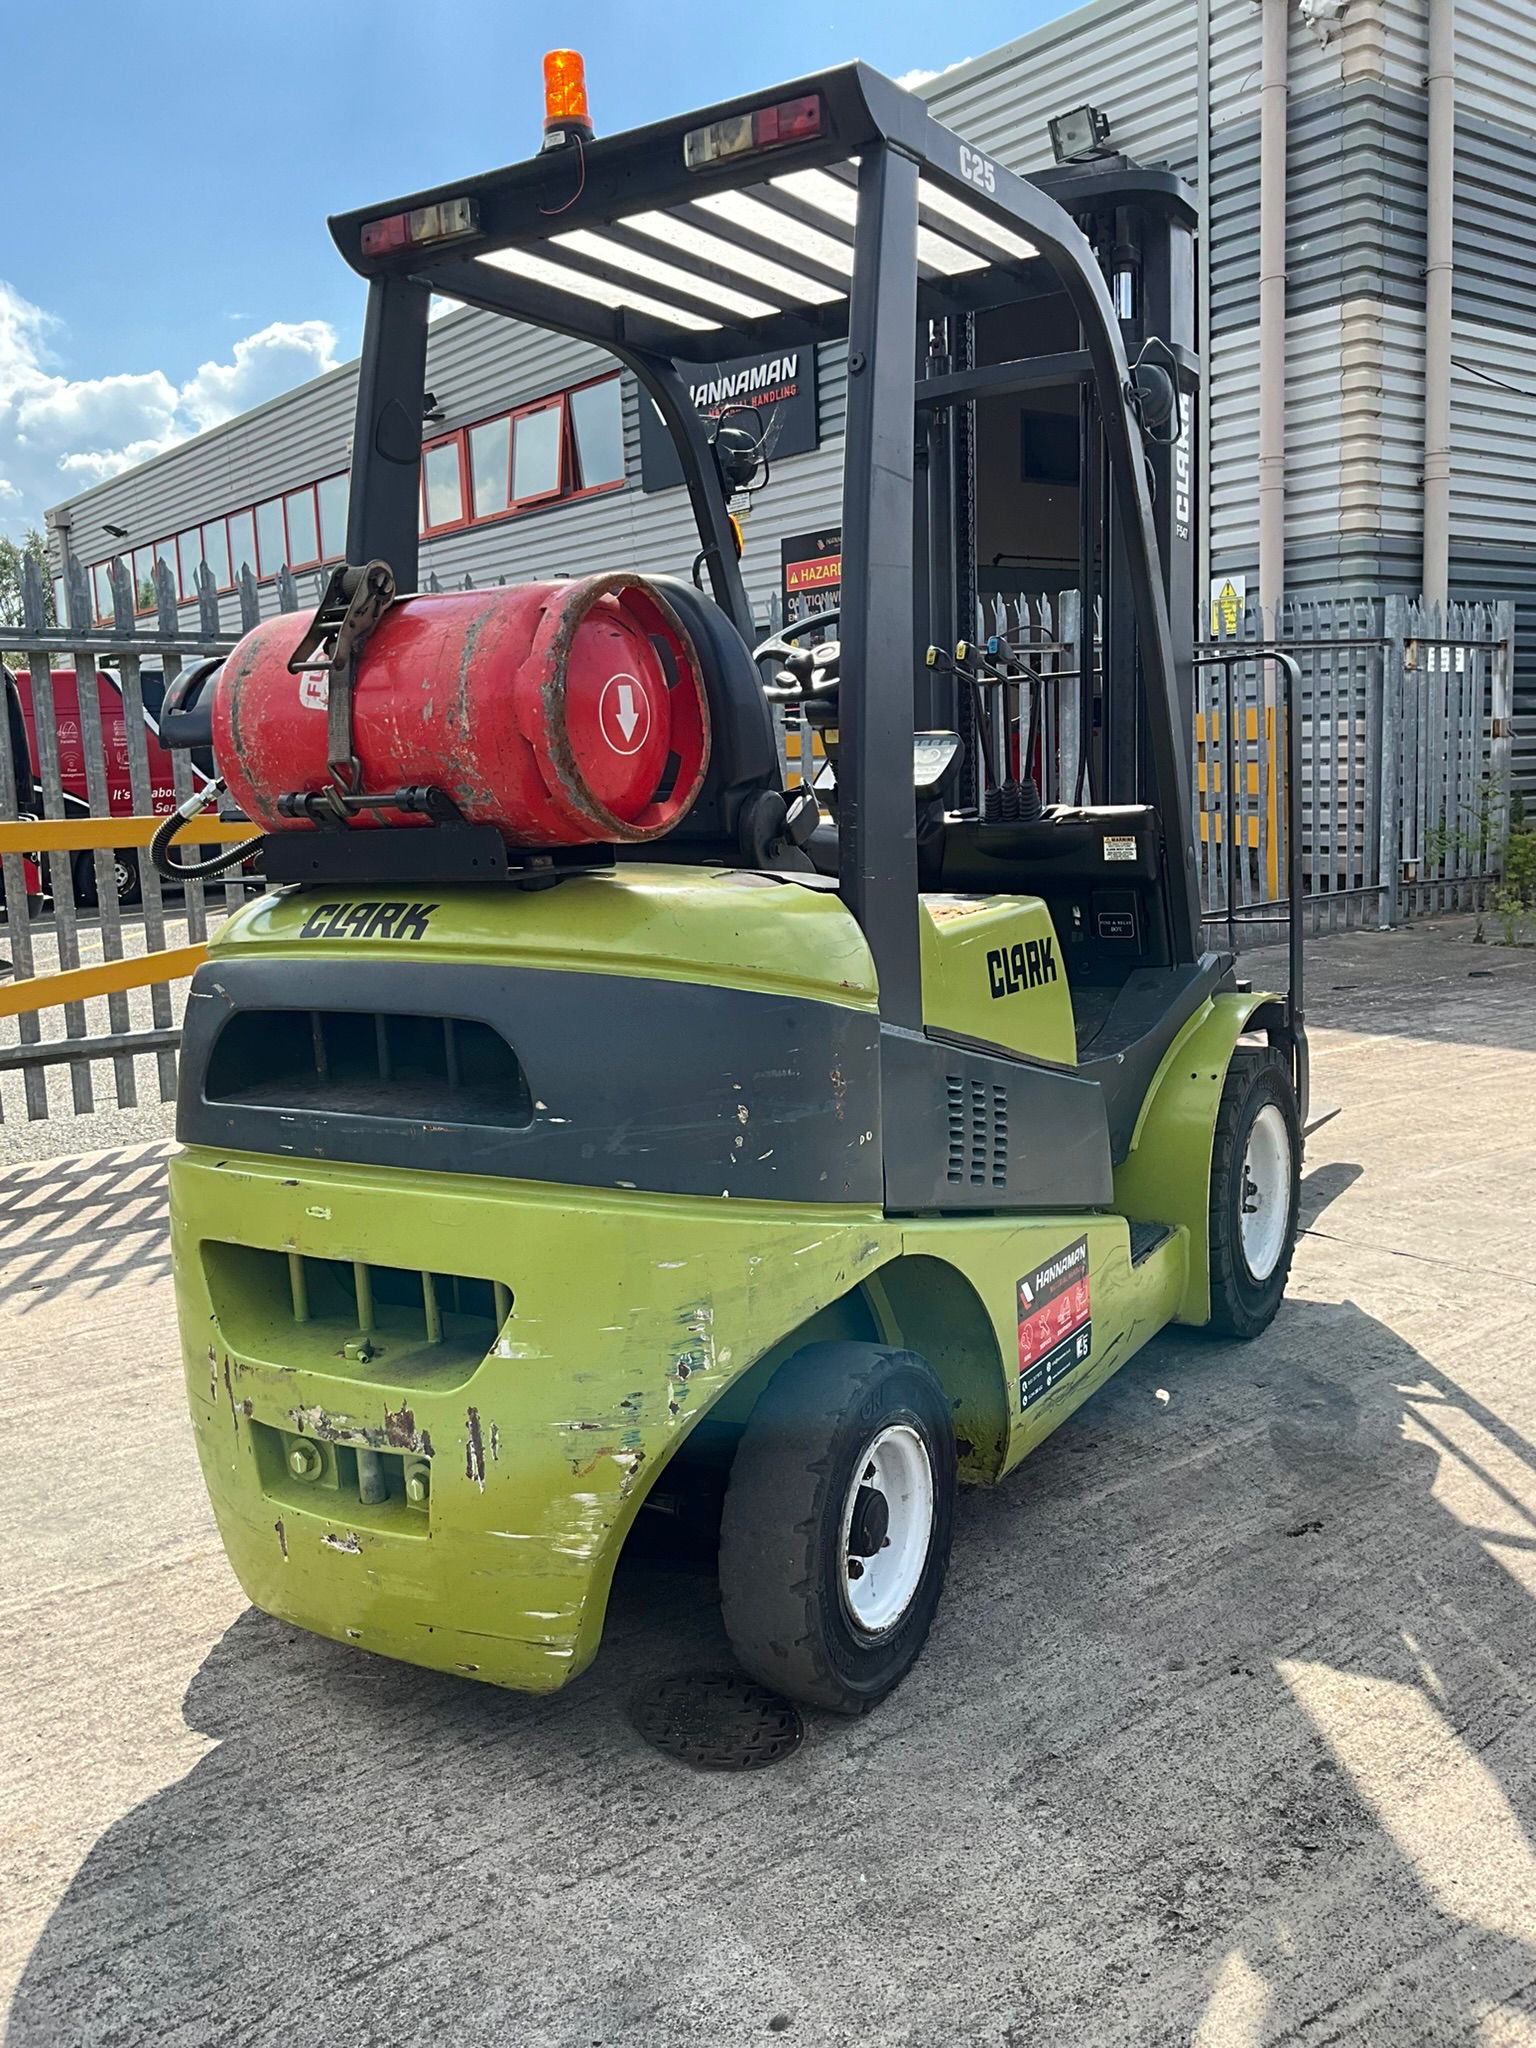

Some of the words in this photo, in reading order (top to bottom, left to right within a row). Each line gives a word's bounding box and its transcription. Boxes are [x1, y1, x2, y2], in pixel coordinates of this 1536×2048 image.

[959, 144, 996, 194] C25
[751, 384, 797, 408] HANDLING
[113, 789, 131, 800] It's
[300, 902, 440, 940] CLARK
[987, 936, 1057, 1000] CLARK
[1035, 1243, 1086, 1292] HANNAMAN
